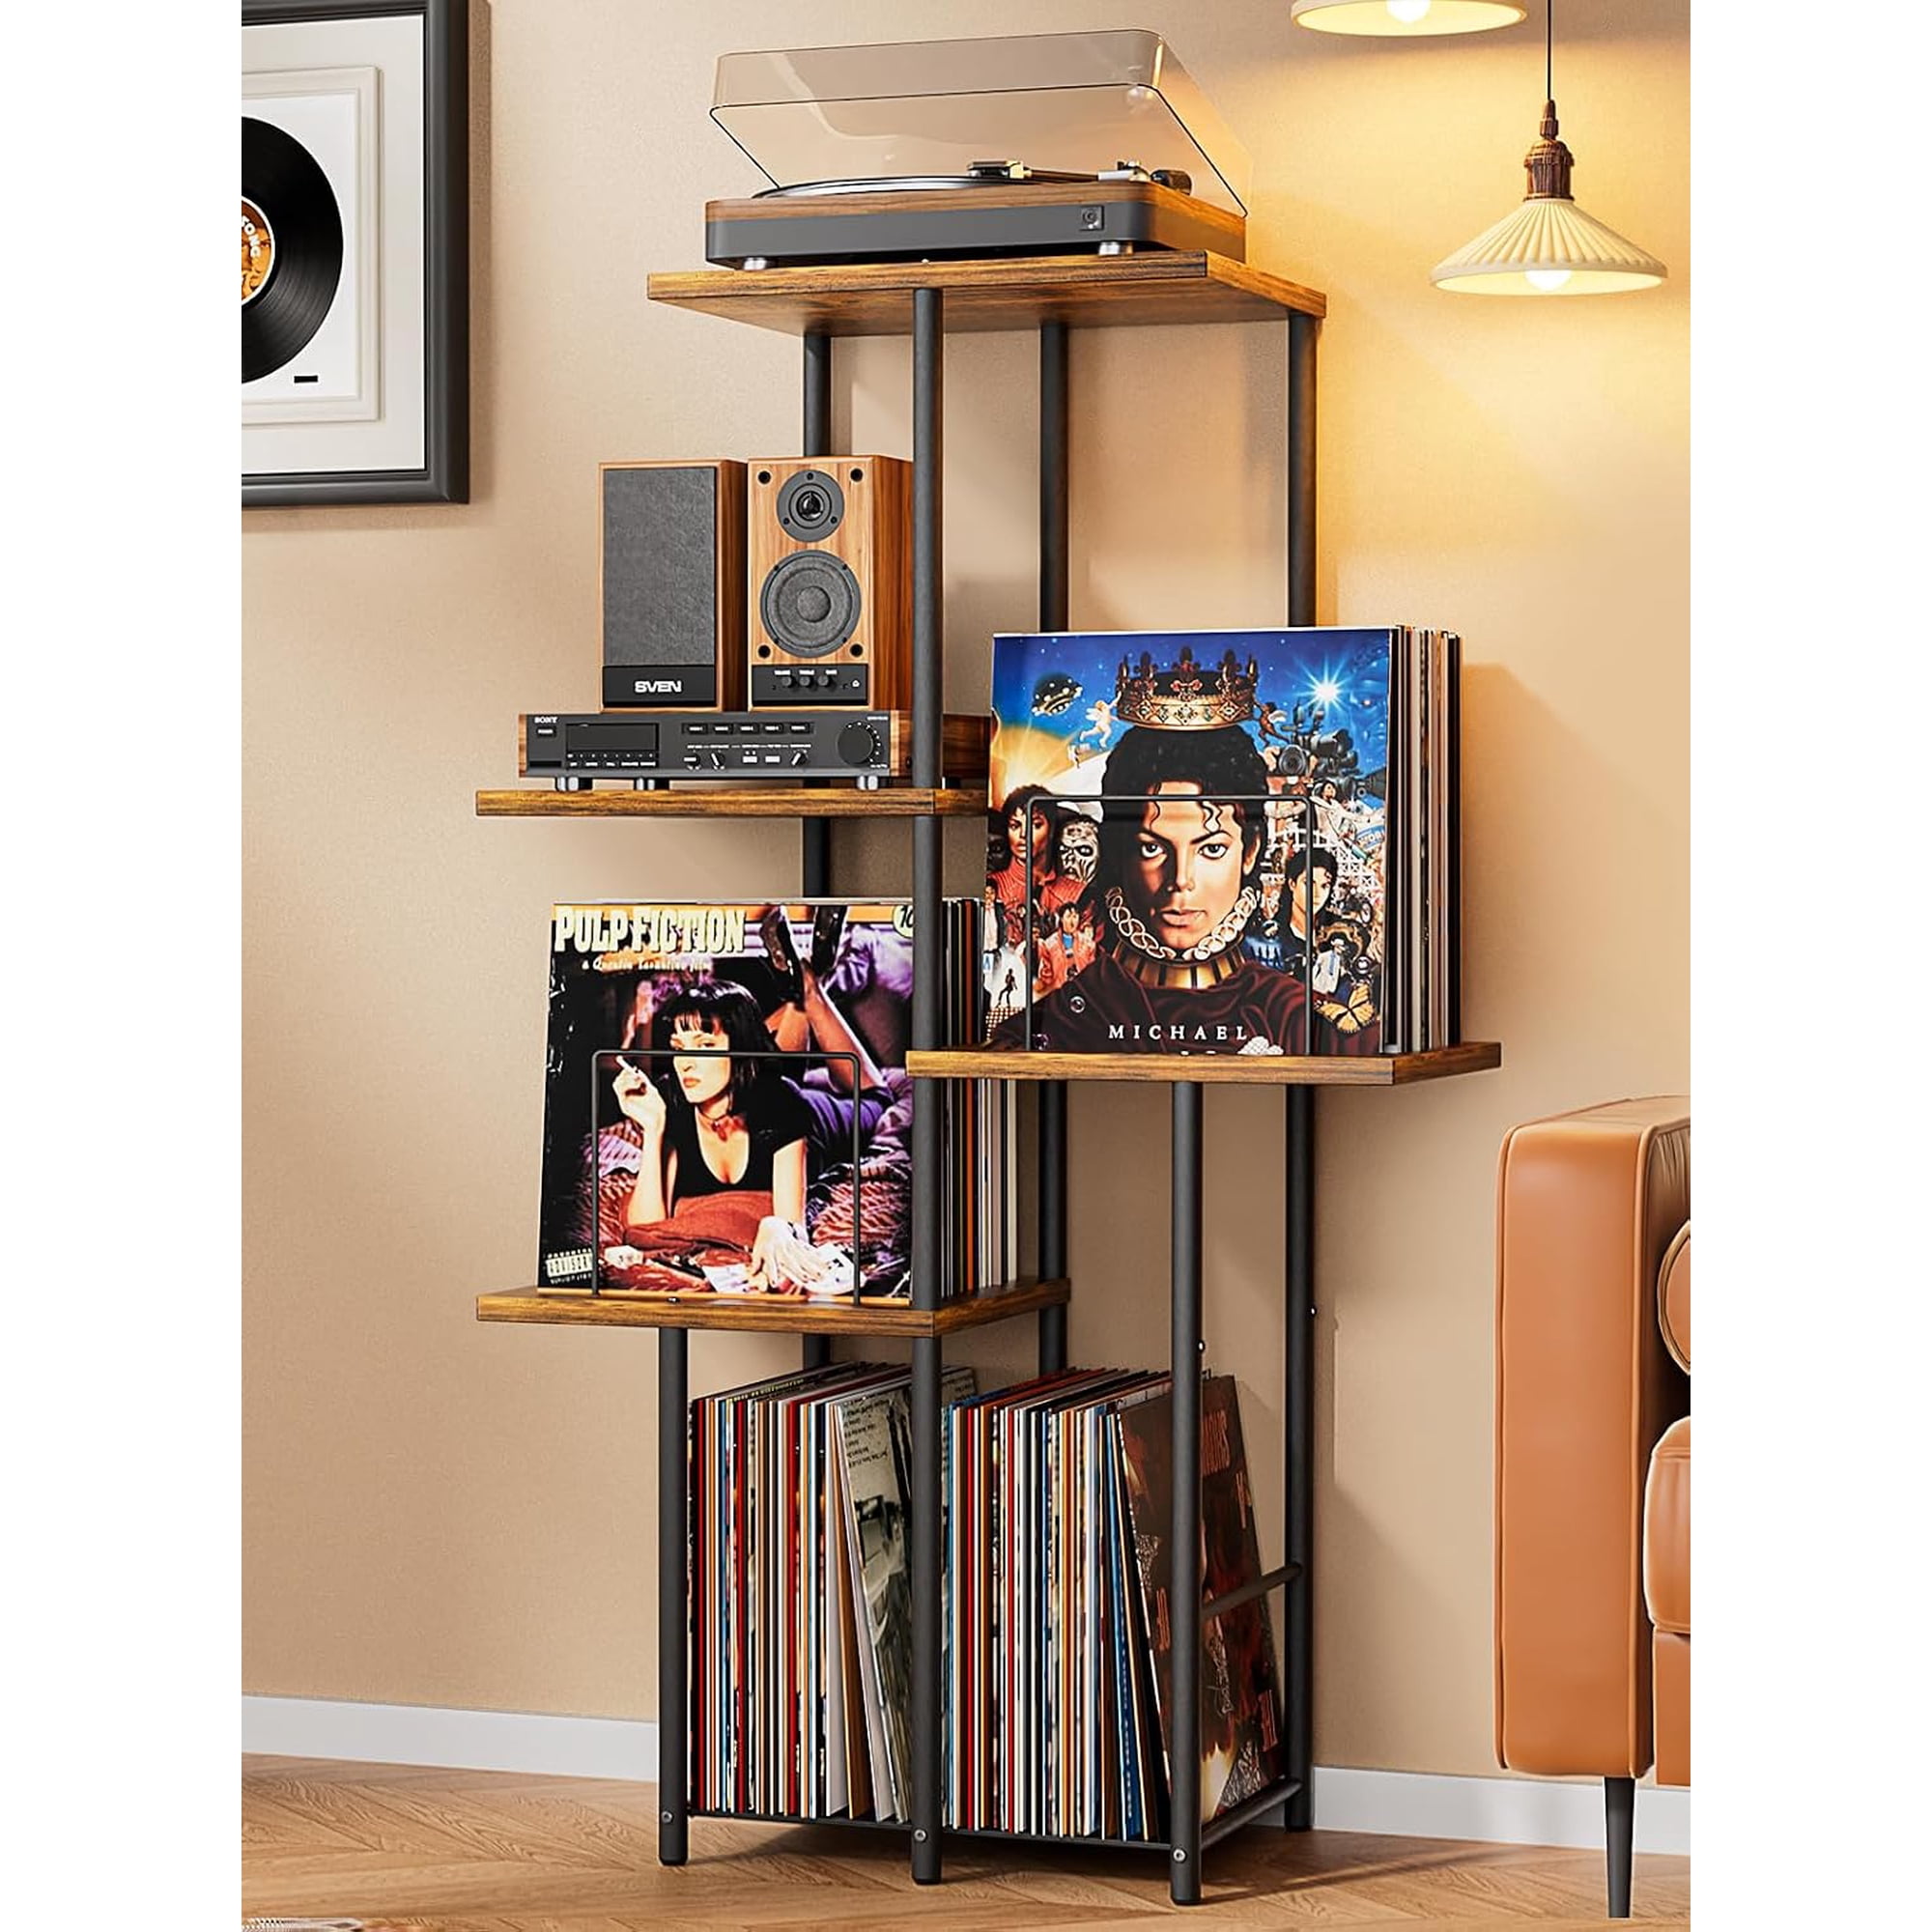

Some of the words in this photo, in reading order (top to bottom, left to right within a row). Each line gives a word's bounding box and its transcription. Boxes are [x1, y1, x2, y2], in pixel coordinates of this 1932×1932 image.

[634, 680, 682, 694] SVEN
[554, 905, 629, 952] PULP
[631, 906, 746, 953] FICTION
[1108, 1025, 1247, 1040] MICHAEL
